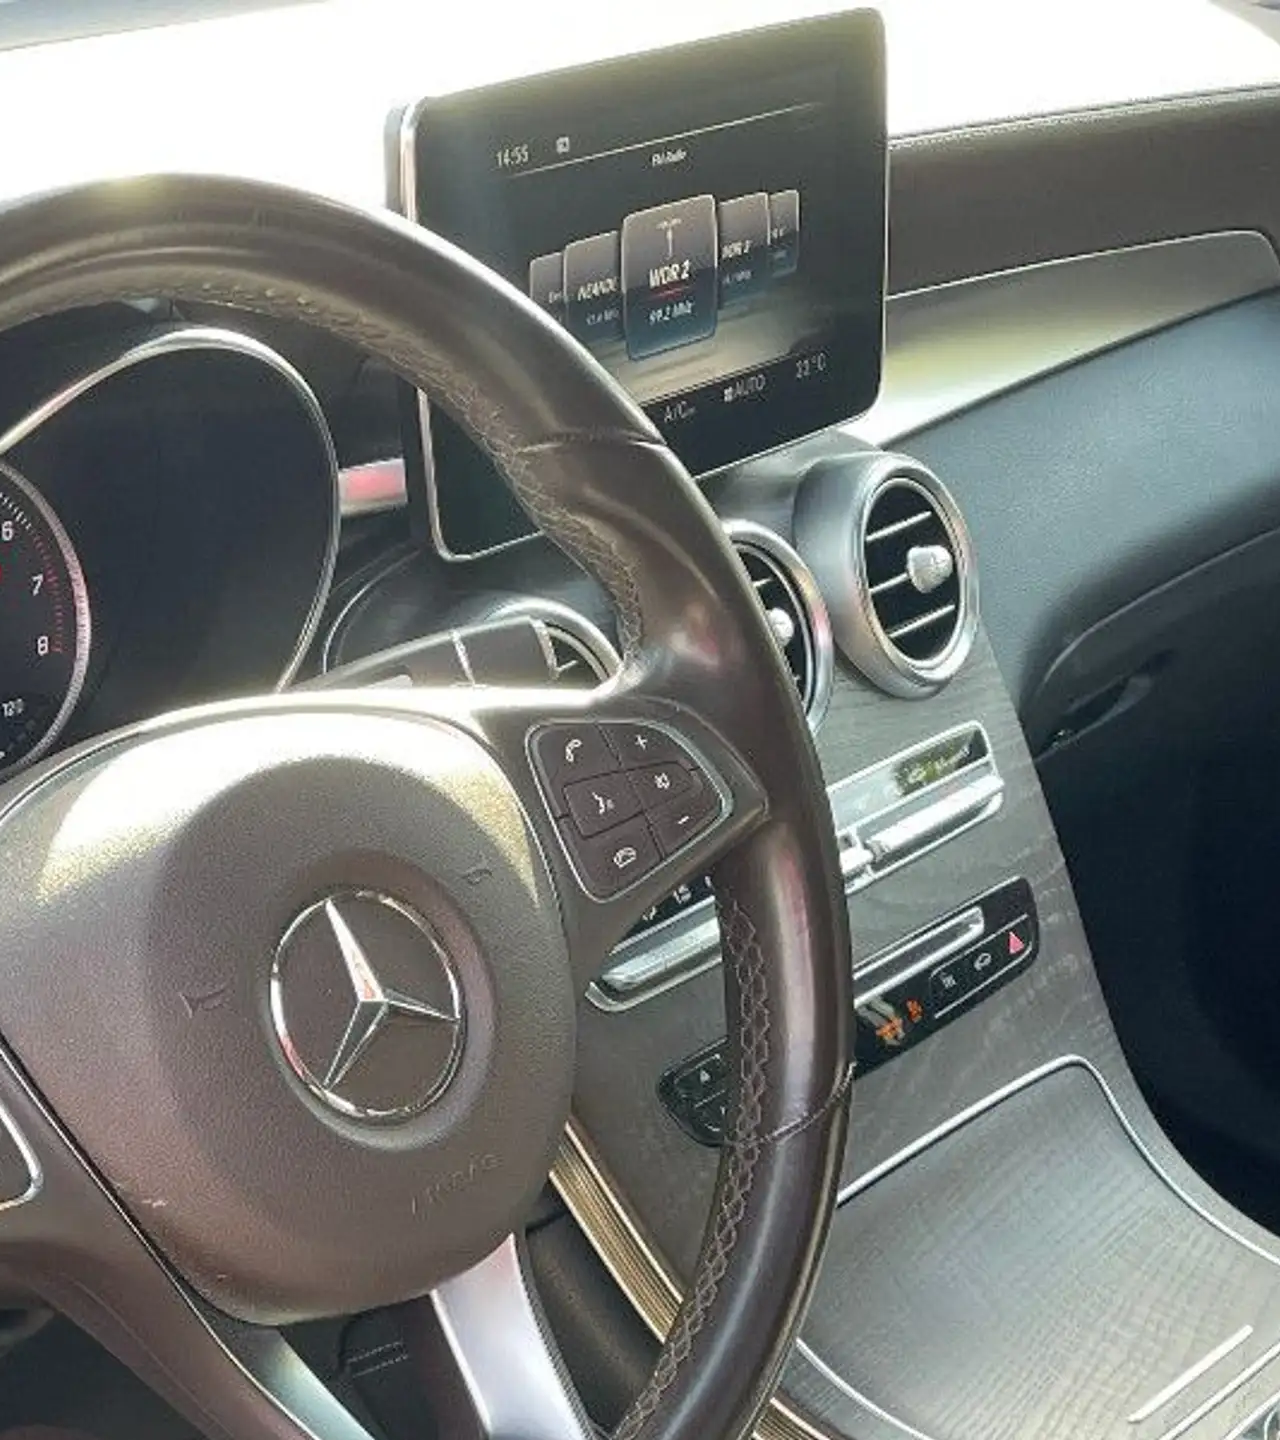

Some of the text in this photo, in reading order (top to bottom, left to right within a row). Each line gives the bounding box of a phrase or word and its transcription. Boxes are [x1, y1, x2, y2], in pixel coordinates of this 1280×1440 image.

[496, 144, 529, 168] 14:55
[649, 259, 691, 289] WDR 2
[0, 520, 14, 541] 6
[31, 573, 44, 597] 7
[36, 635, 50, 656] 8
